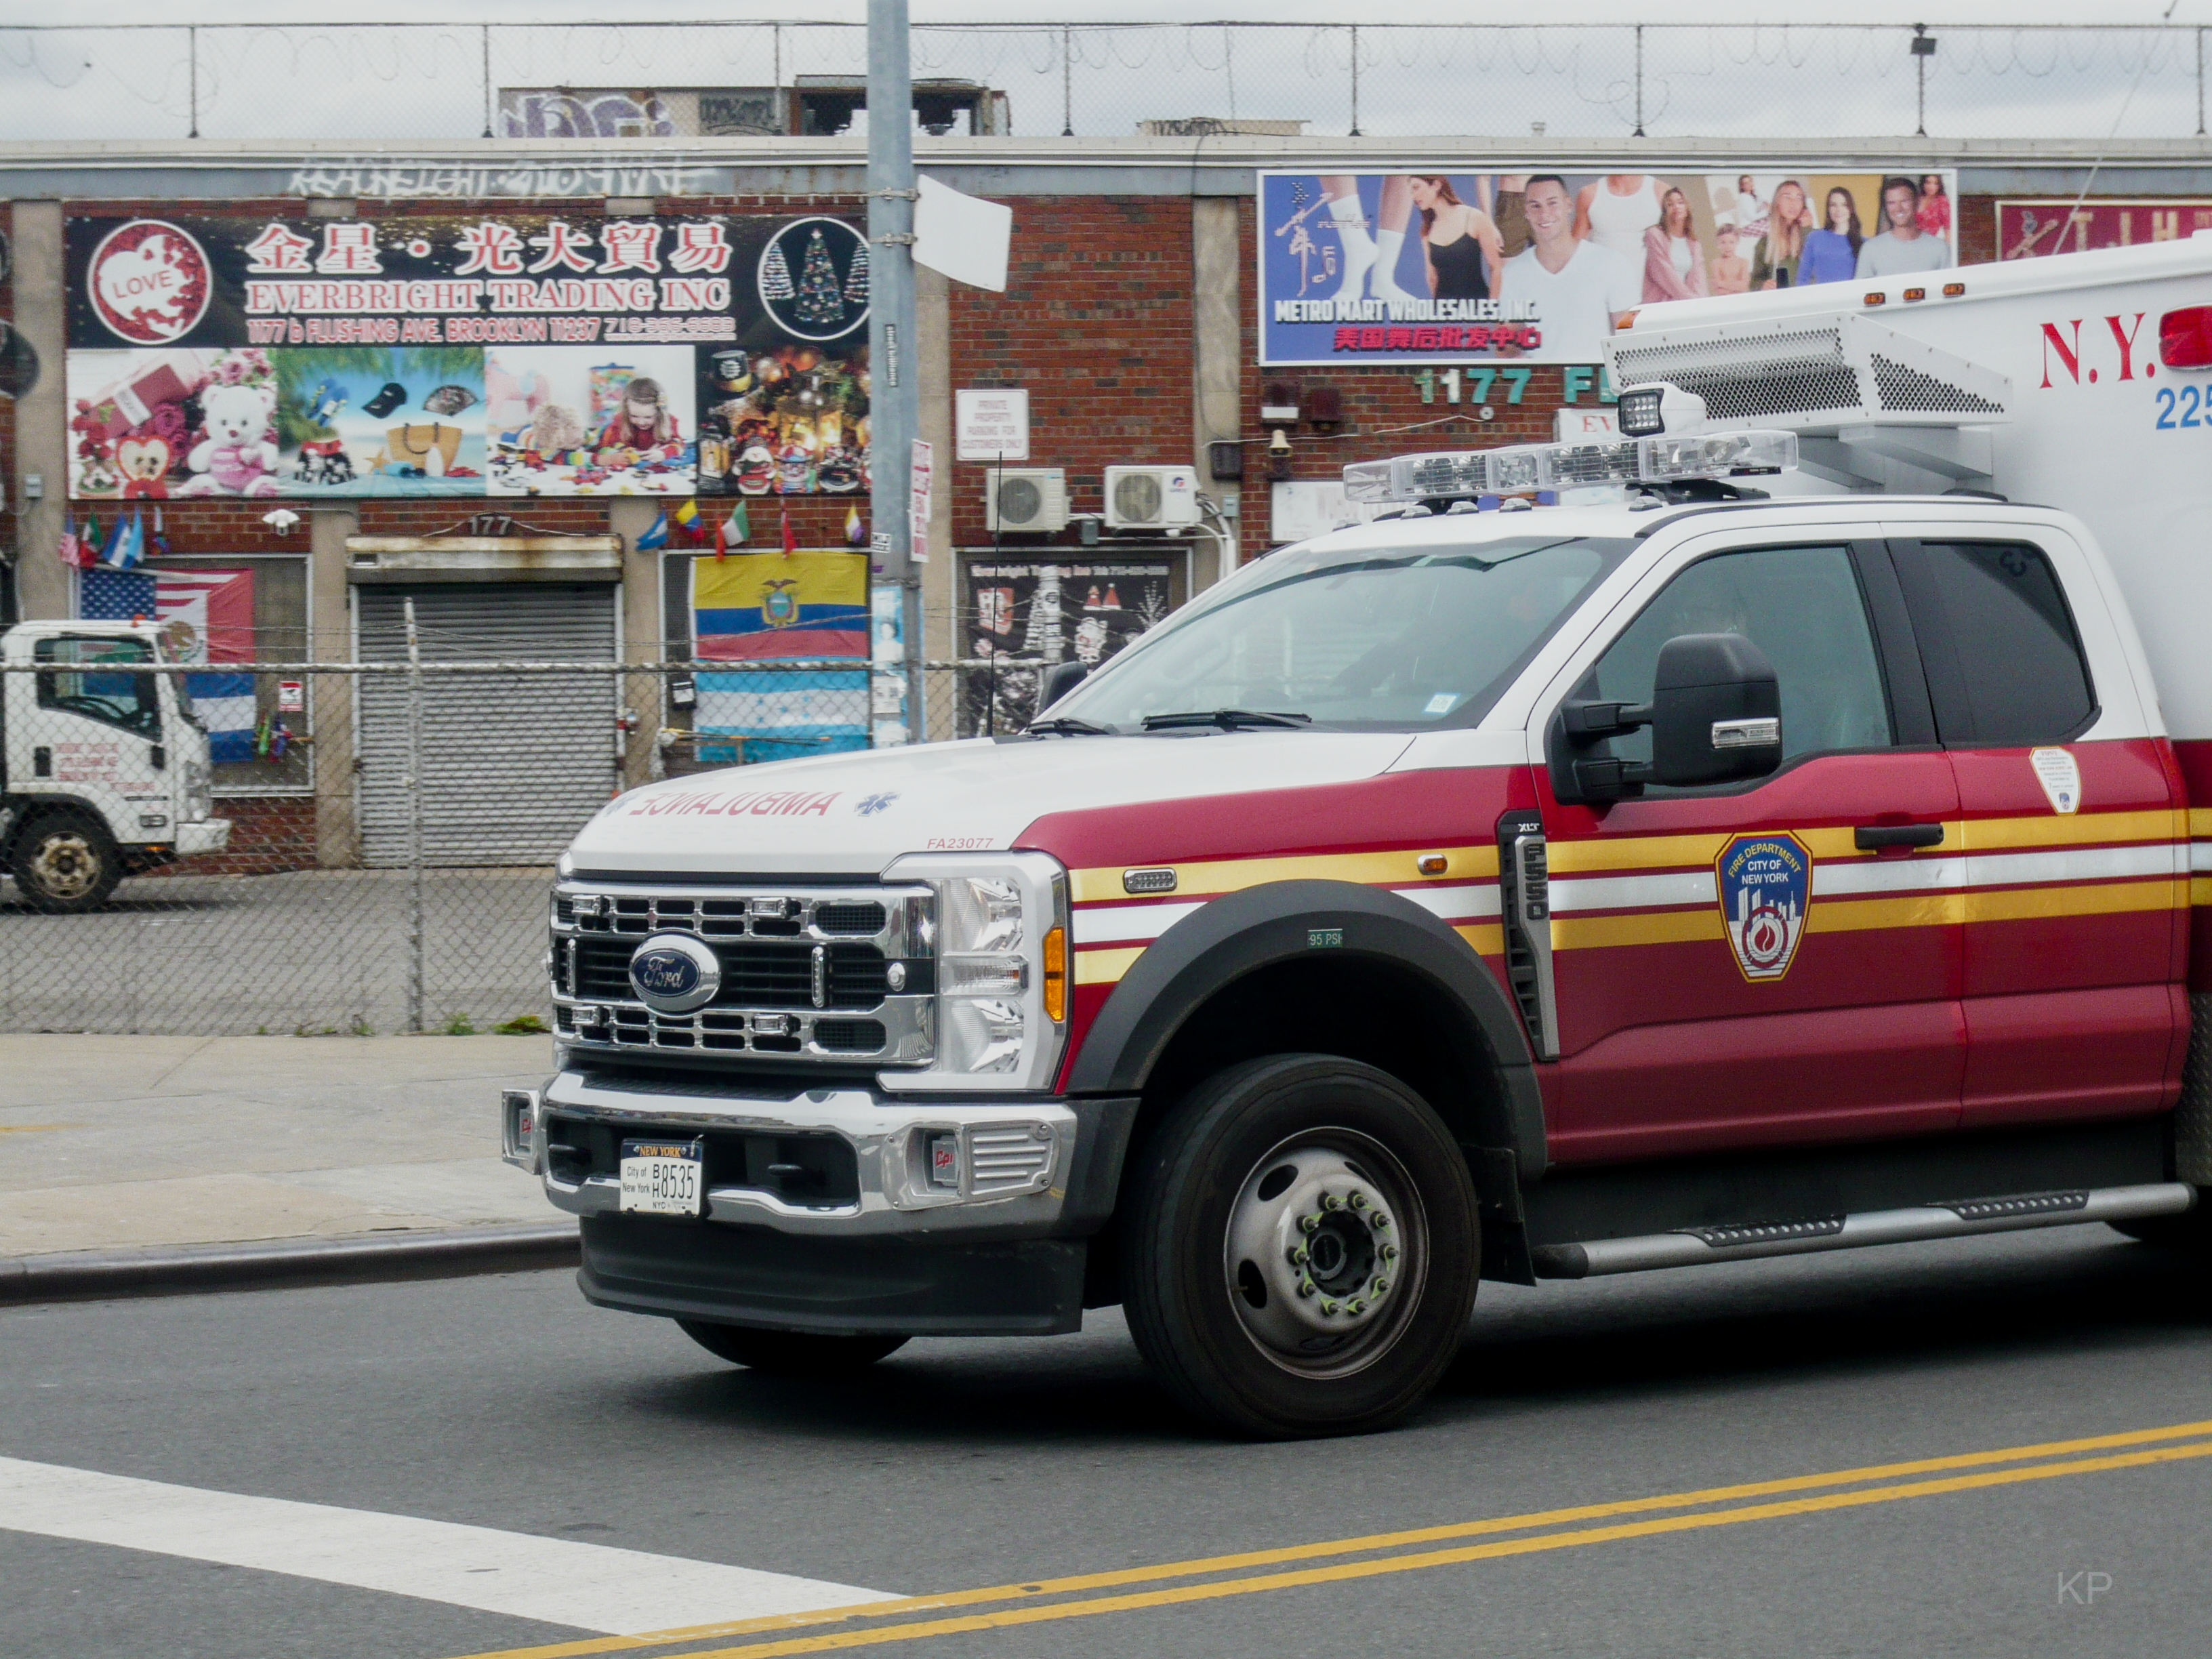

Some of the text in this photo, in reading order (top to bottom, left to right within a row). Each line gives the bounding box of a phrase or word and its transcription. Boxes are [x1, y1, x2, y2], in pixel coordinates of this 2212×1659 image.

[112, 270, 173, 298] LOVE
[245, 278, 731, 314] EVERBRIGHT TRADING INC
[1274, 299, 1333, 323] METRO
[1336, 299, 1383, 323] MART
[246, 319, 287, 342] 1177
[306, 318, 398, 343] FLUSHING
[445, 317, 546, 342] BROOKLYN
[548, 316, 601, 341] 11237
[1334, 326, 1542, 350] 美国舞后批发中心
[2039, 312, 2156, 389] N.Y.
[1413, 368, 1532, 404] 1177
[470, 516, 511, 535] 177
[1518, 823, 1540, 832] XLT
[927, 838, 994, 849] FA23077
[1729, 843, 1801, 878] FIRE DEPARTMENT
[1748, 860, 1782, 871] CITY OF
[1741, 872, 1789, 885] NEW YORK
[1309, 933, 1341, 946] 95 PSI
[643, 956, 685, 988] Ford
[639, 1145, 681, 1158] NEW YORK
[627, 1166, 647, 1179] City of
[622, 1182, 651, 1193] New York
